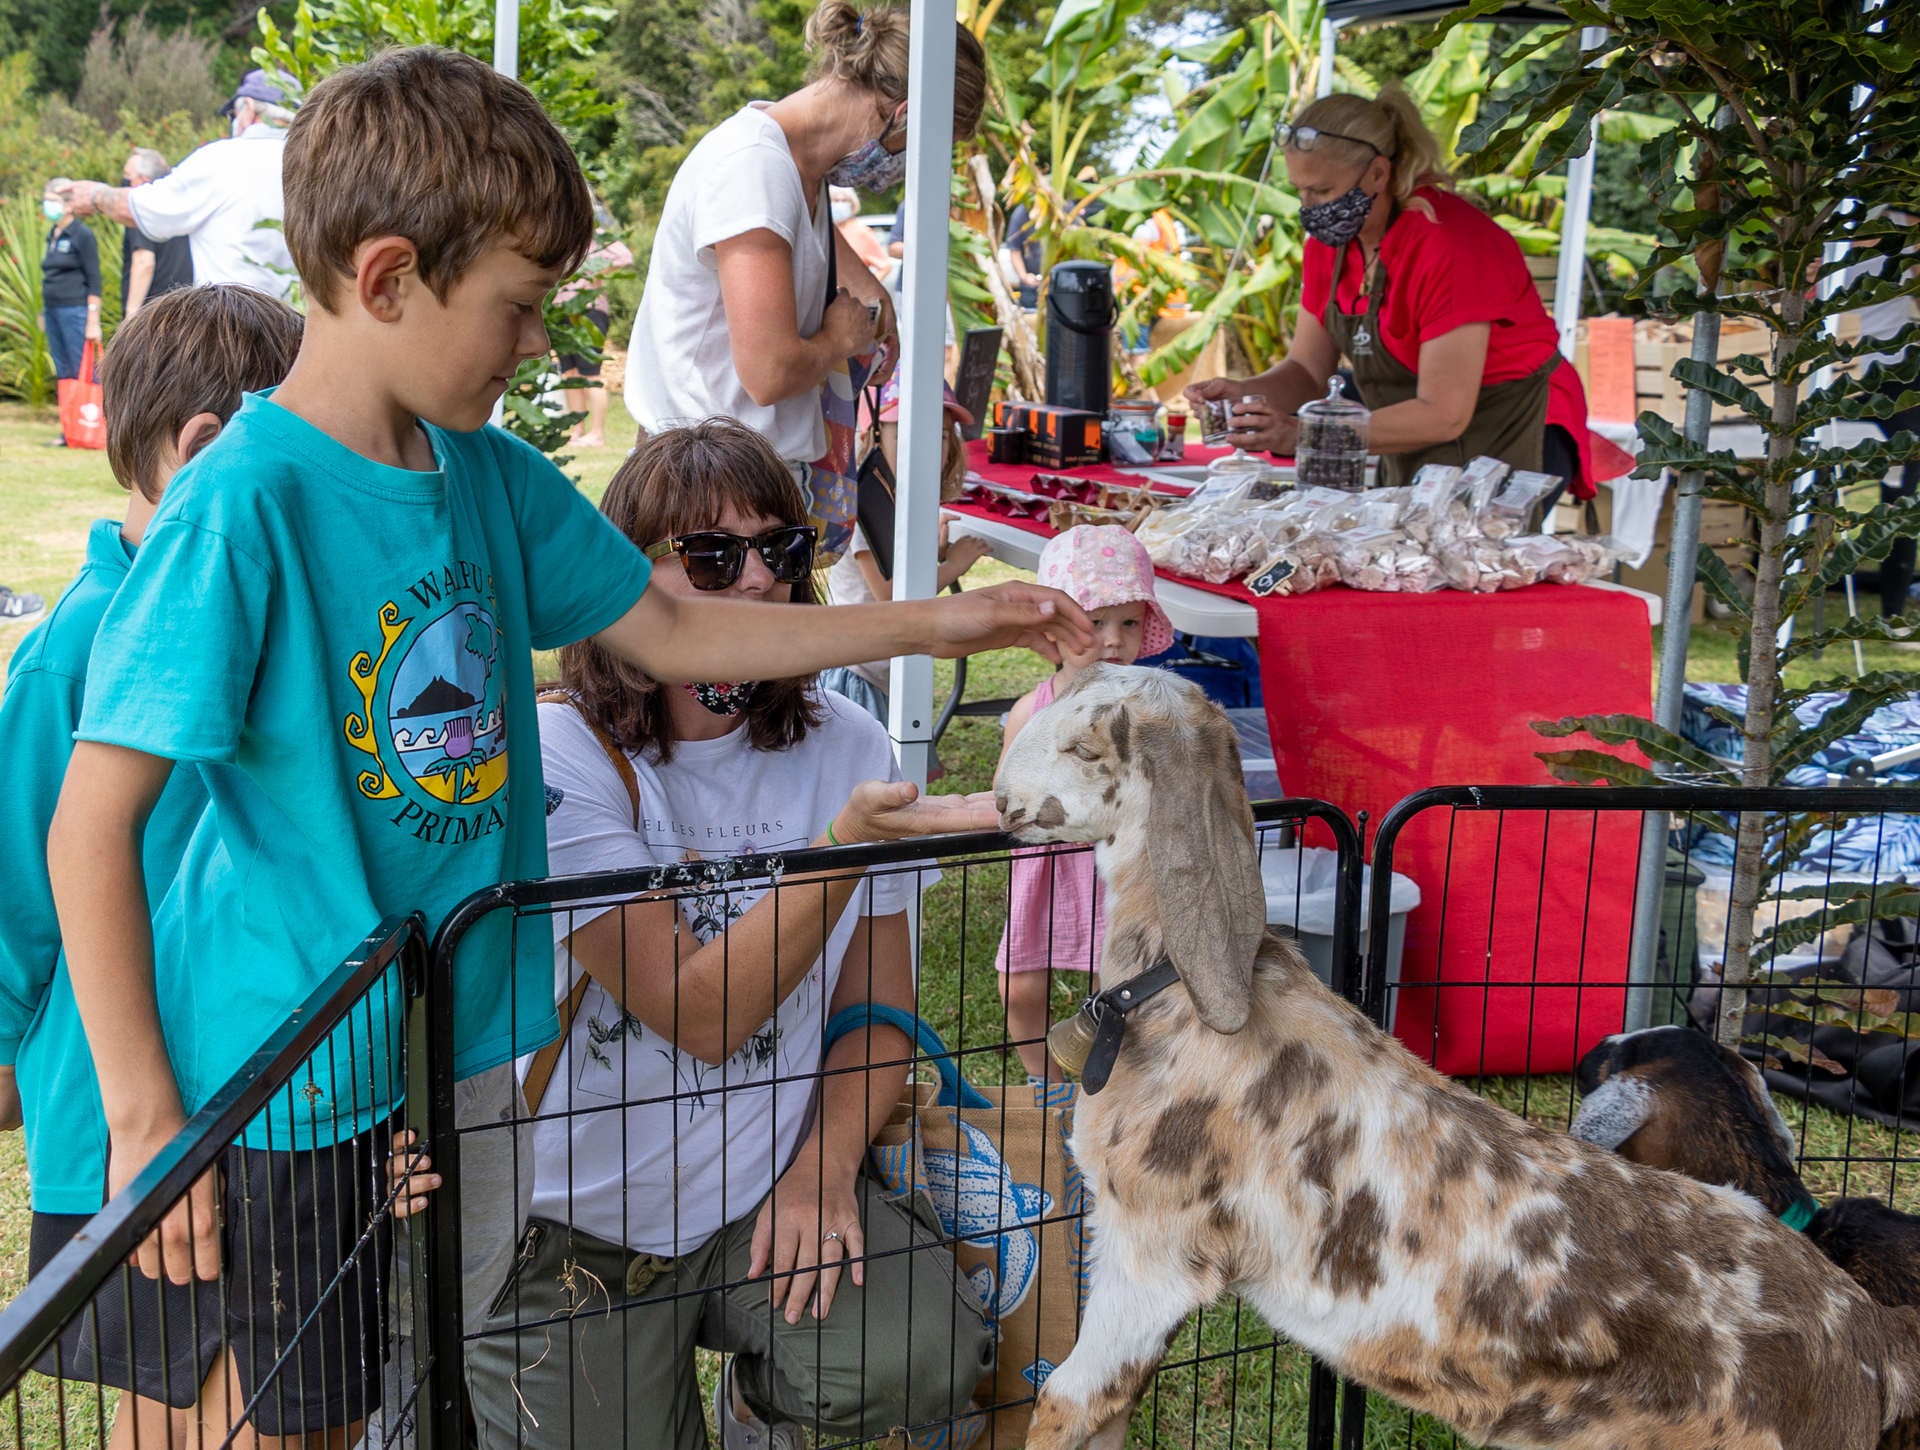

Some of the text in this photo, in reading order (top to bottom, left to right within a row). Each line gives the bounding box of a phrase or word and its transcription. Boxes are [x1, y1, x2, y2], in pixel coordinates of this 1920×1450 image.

[405, 561, 483, 610] WAIPU
[389, 794, 508, 845] PRIMA
[643, 818, 784, 838] ELLES FLEURS
